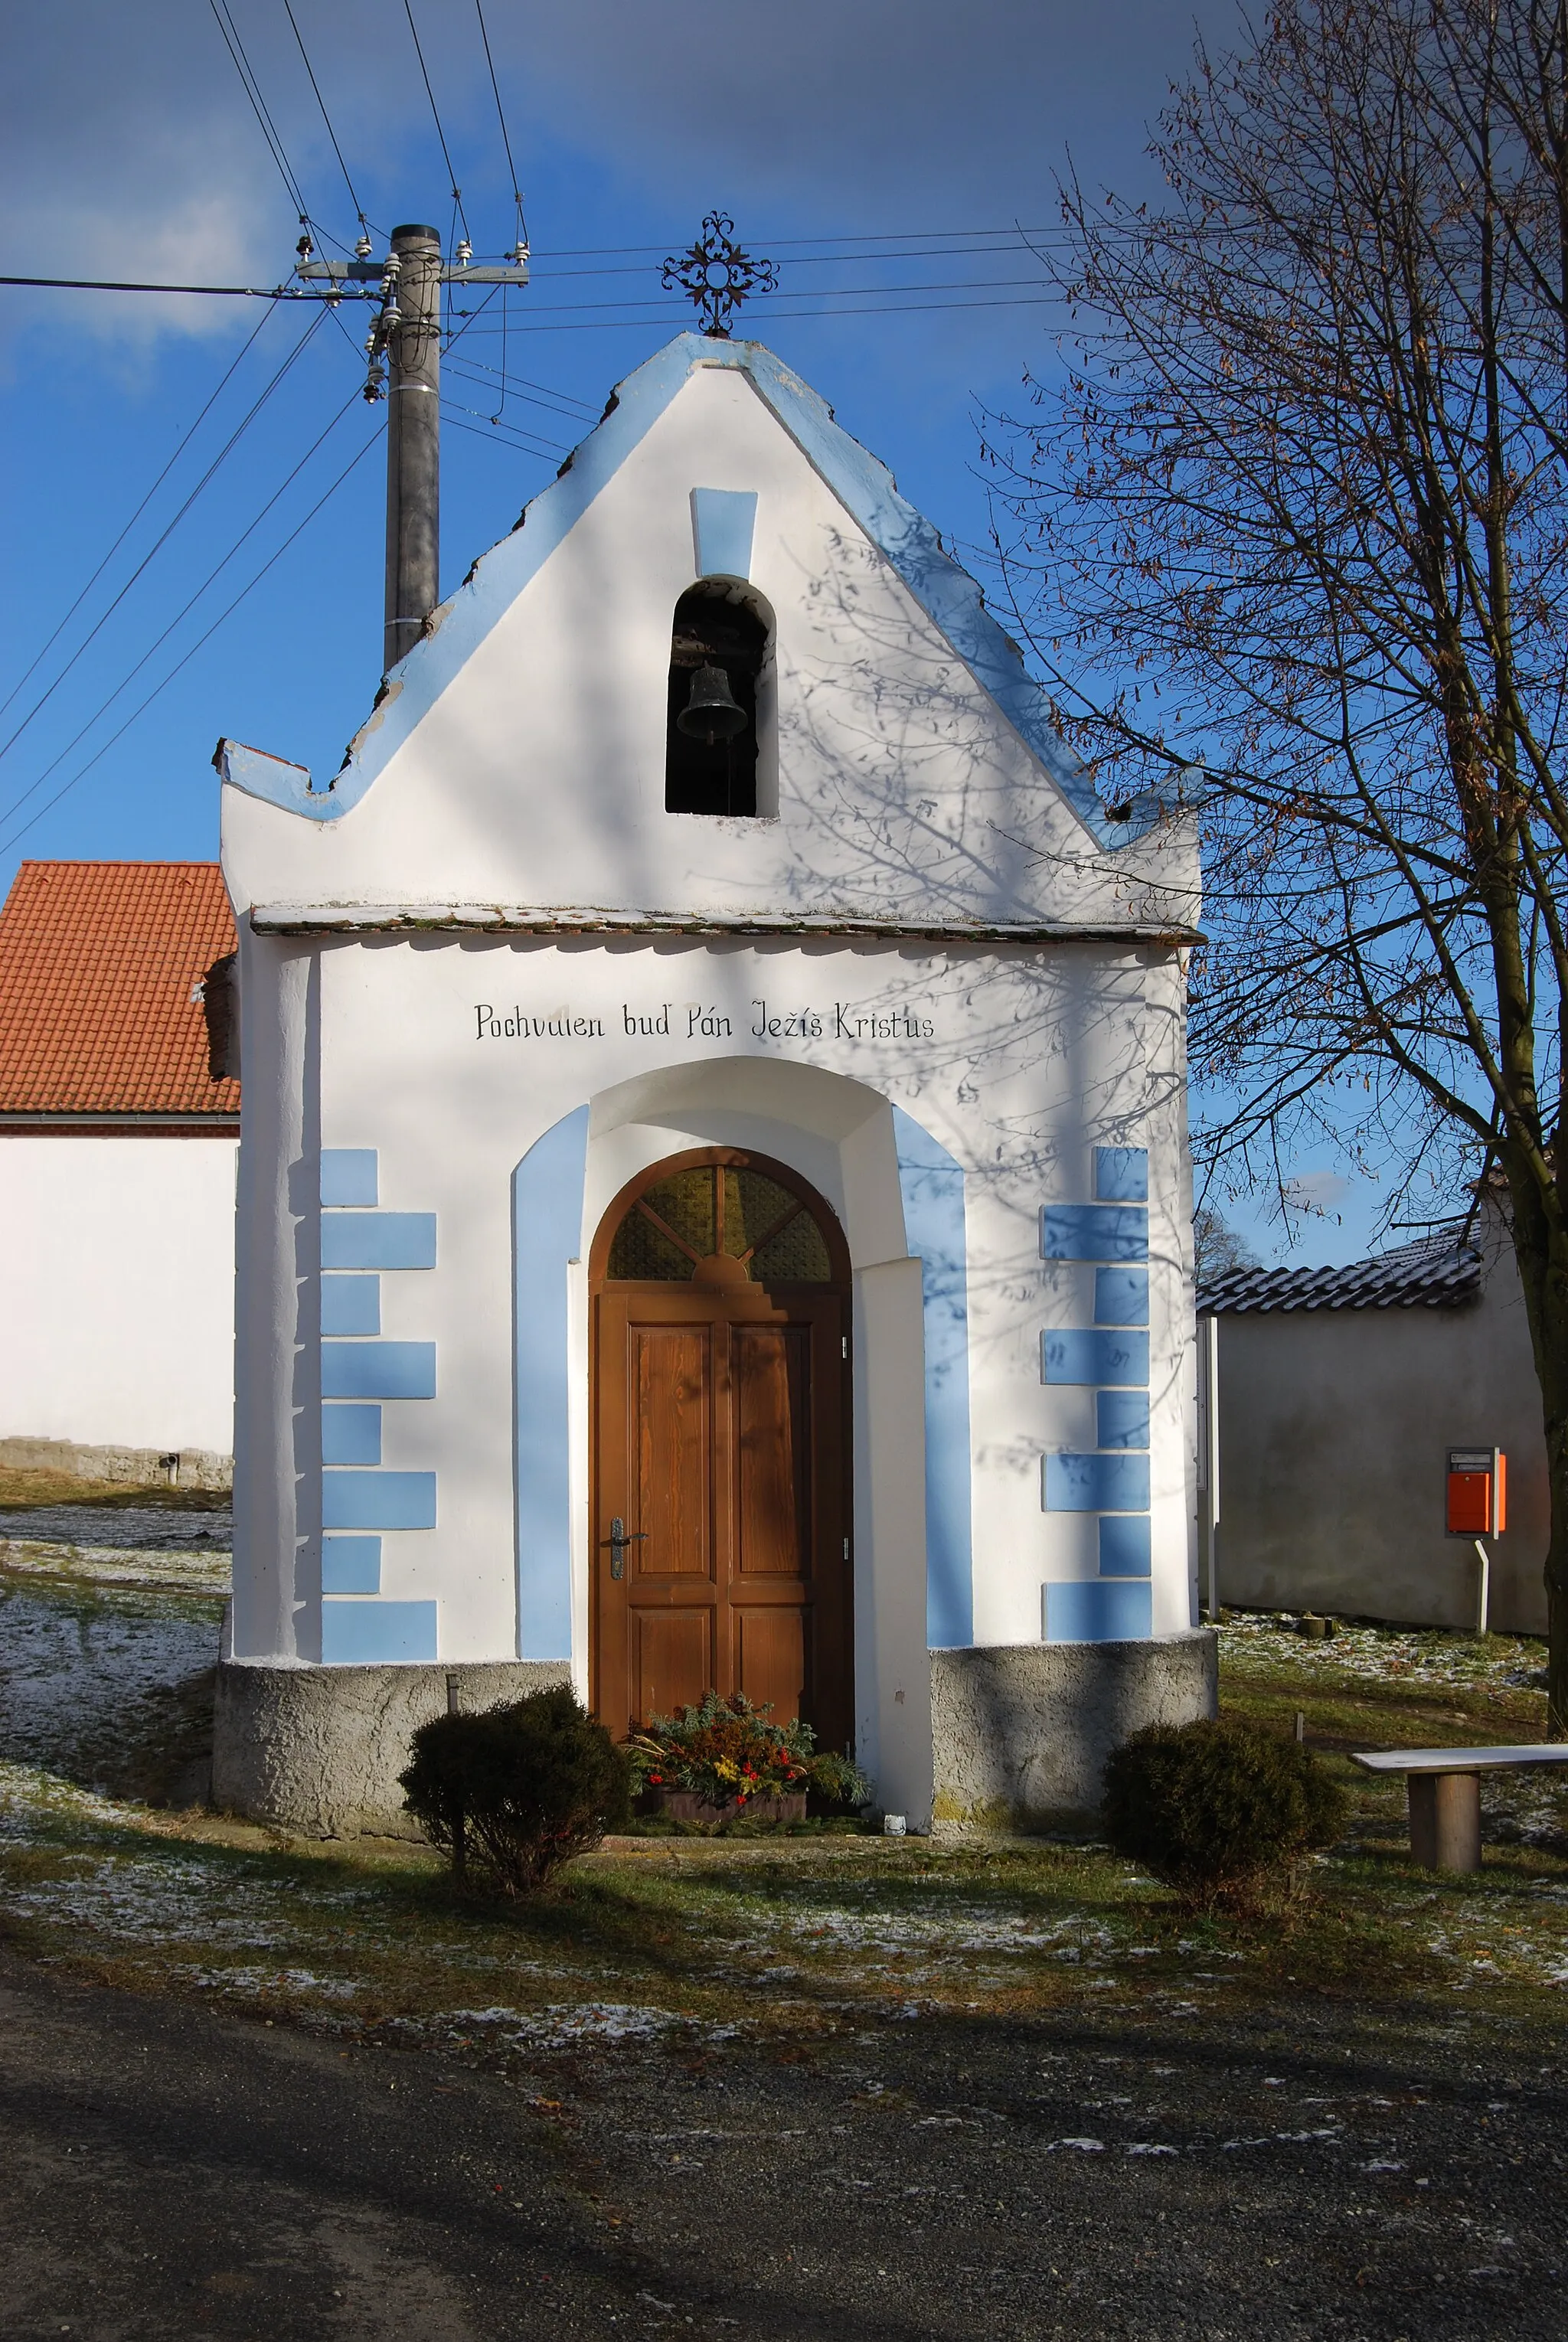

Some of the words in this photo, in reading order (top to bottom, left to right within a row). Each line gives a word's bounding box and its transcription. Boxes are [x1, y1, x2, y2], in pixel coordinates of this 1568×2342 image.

[687, 1005, 733, 1038] Pán
[751, 999, 822, 1037] Ježíš
[834, 1002, 934, 1039] Kristus
